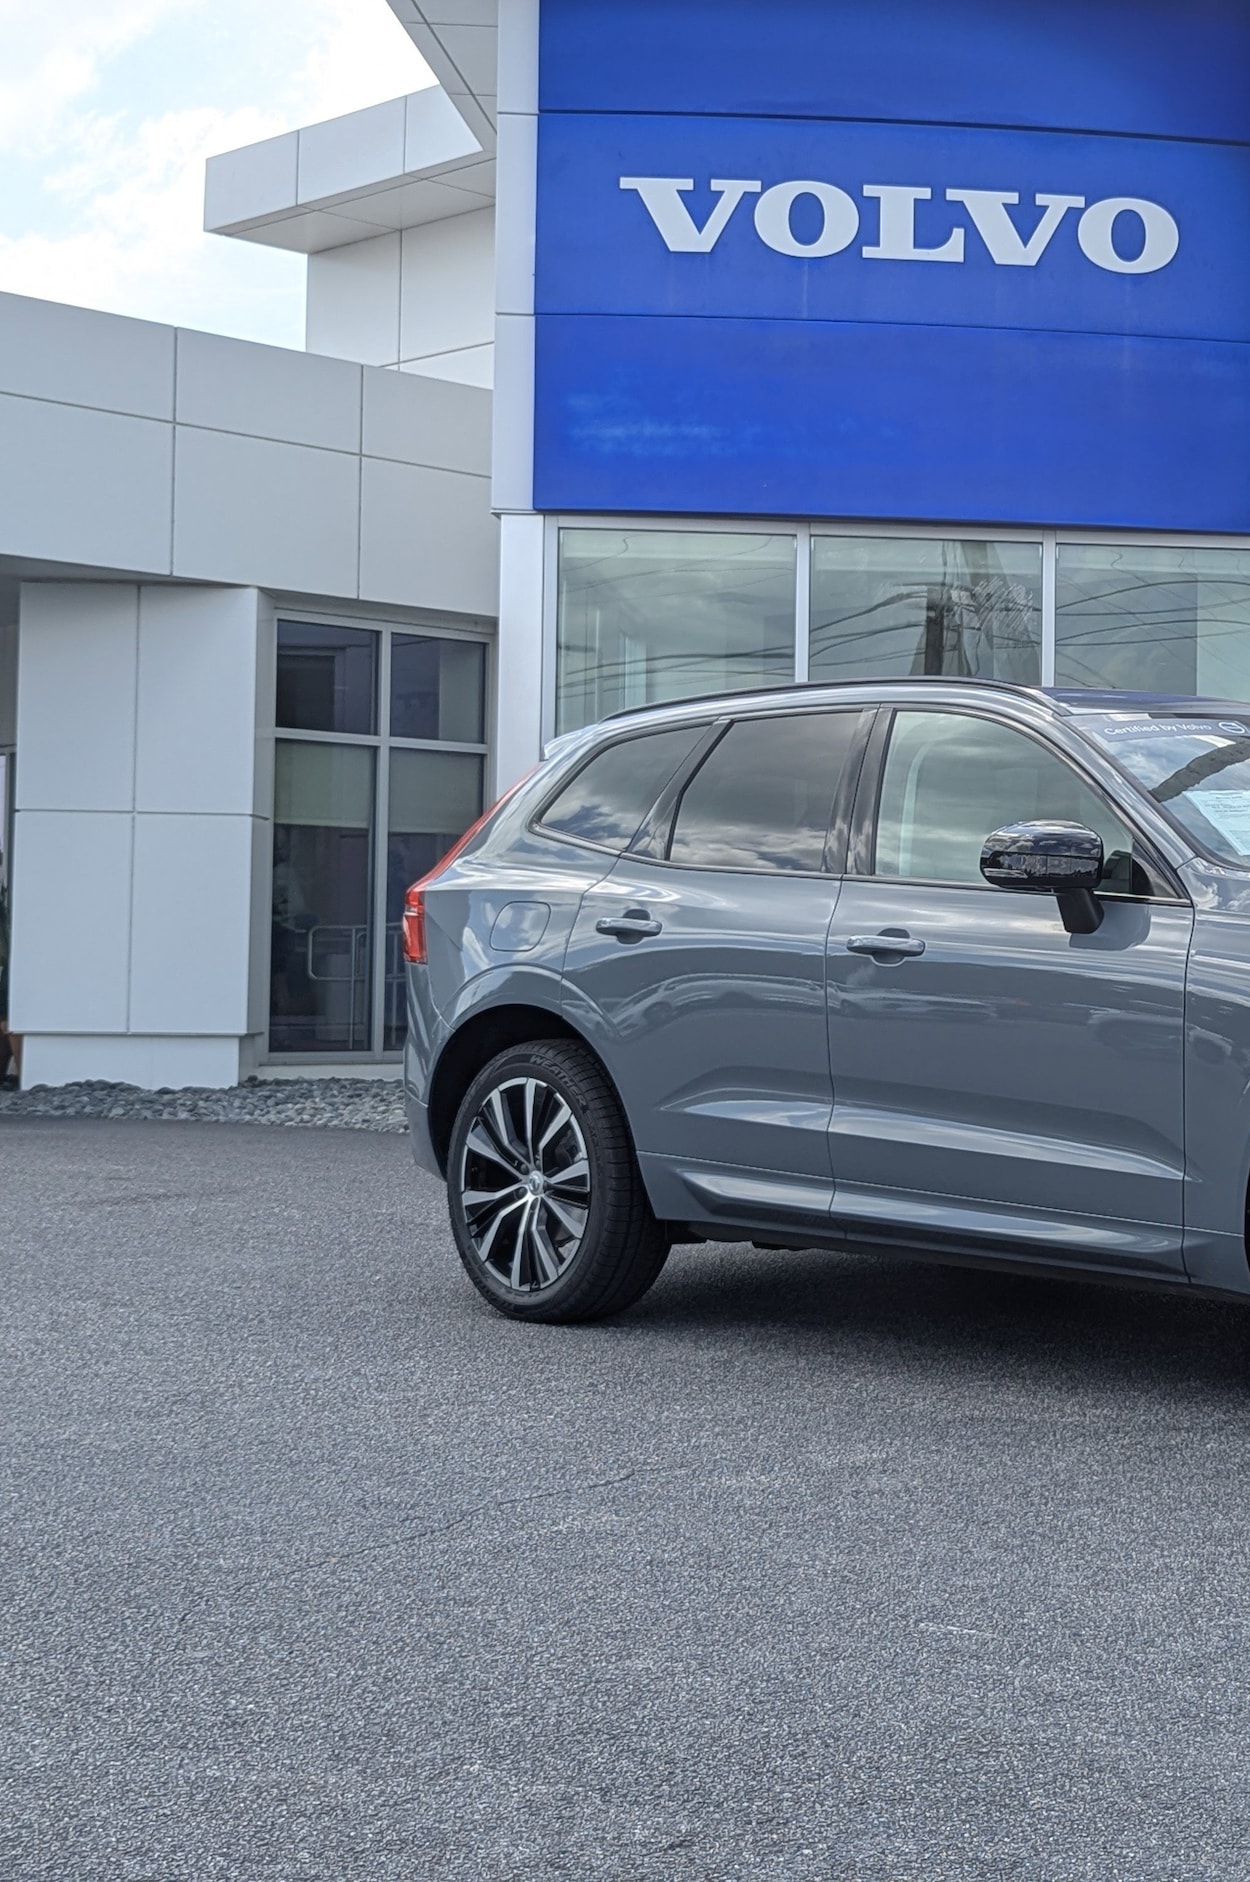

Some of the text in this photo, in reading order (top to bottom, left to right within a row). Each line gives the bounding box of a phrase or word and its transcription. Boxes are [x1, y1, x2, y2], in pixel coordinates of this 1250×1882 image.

[619, 176, 1180, 275] VOLVO
[1104, 723, 1213, 735] Certified by Volvo
[530, 1055, 587, 1106] WEATHER
